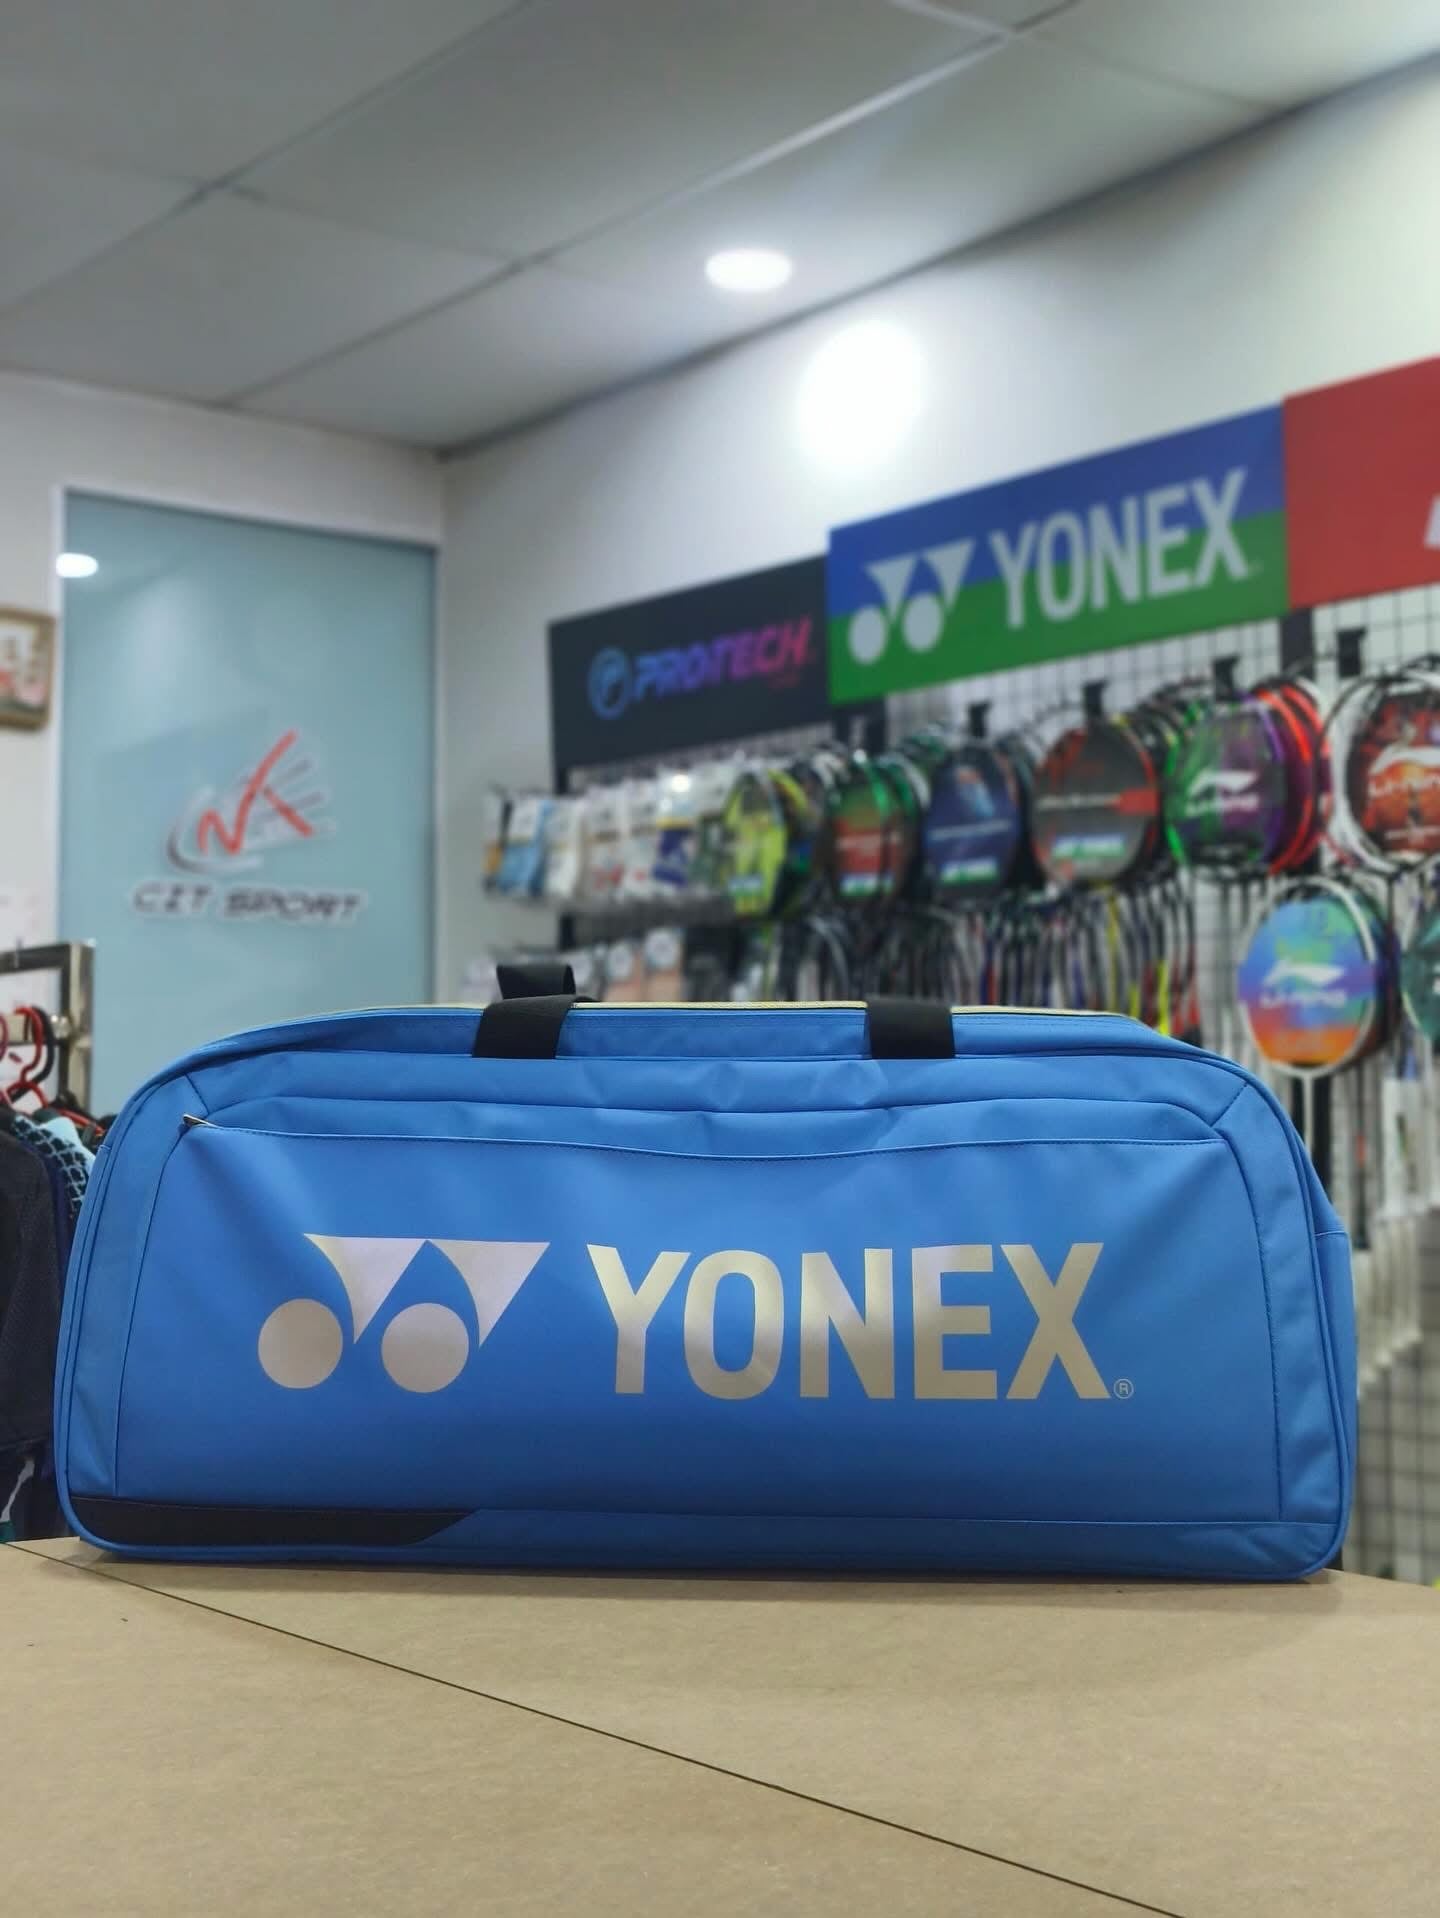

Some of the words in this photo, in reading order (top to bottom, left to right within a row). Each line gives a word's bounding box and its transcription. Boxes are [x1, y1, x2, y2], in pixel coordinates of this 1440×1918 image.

[989, 467, 1248, 629] YONEX
[223, 886, 364, 924] SPORT
[586, 1243, 1110, 1400] YONEX
